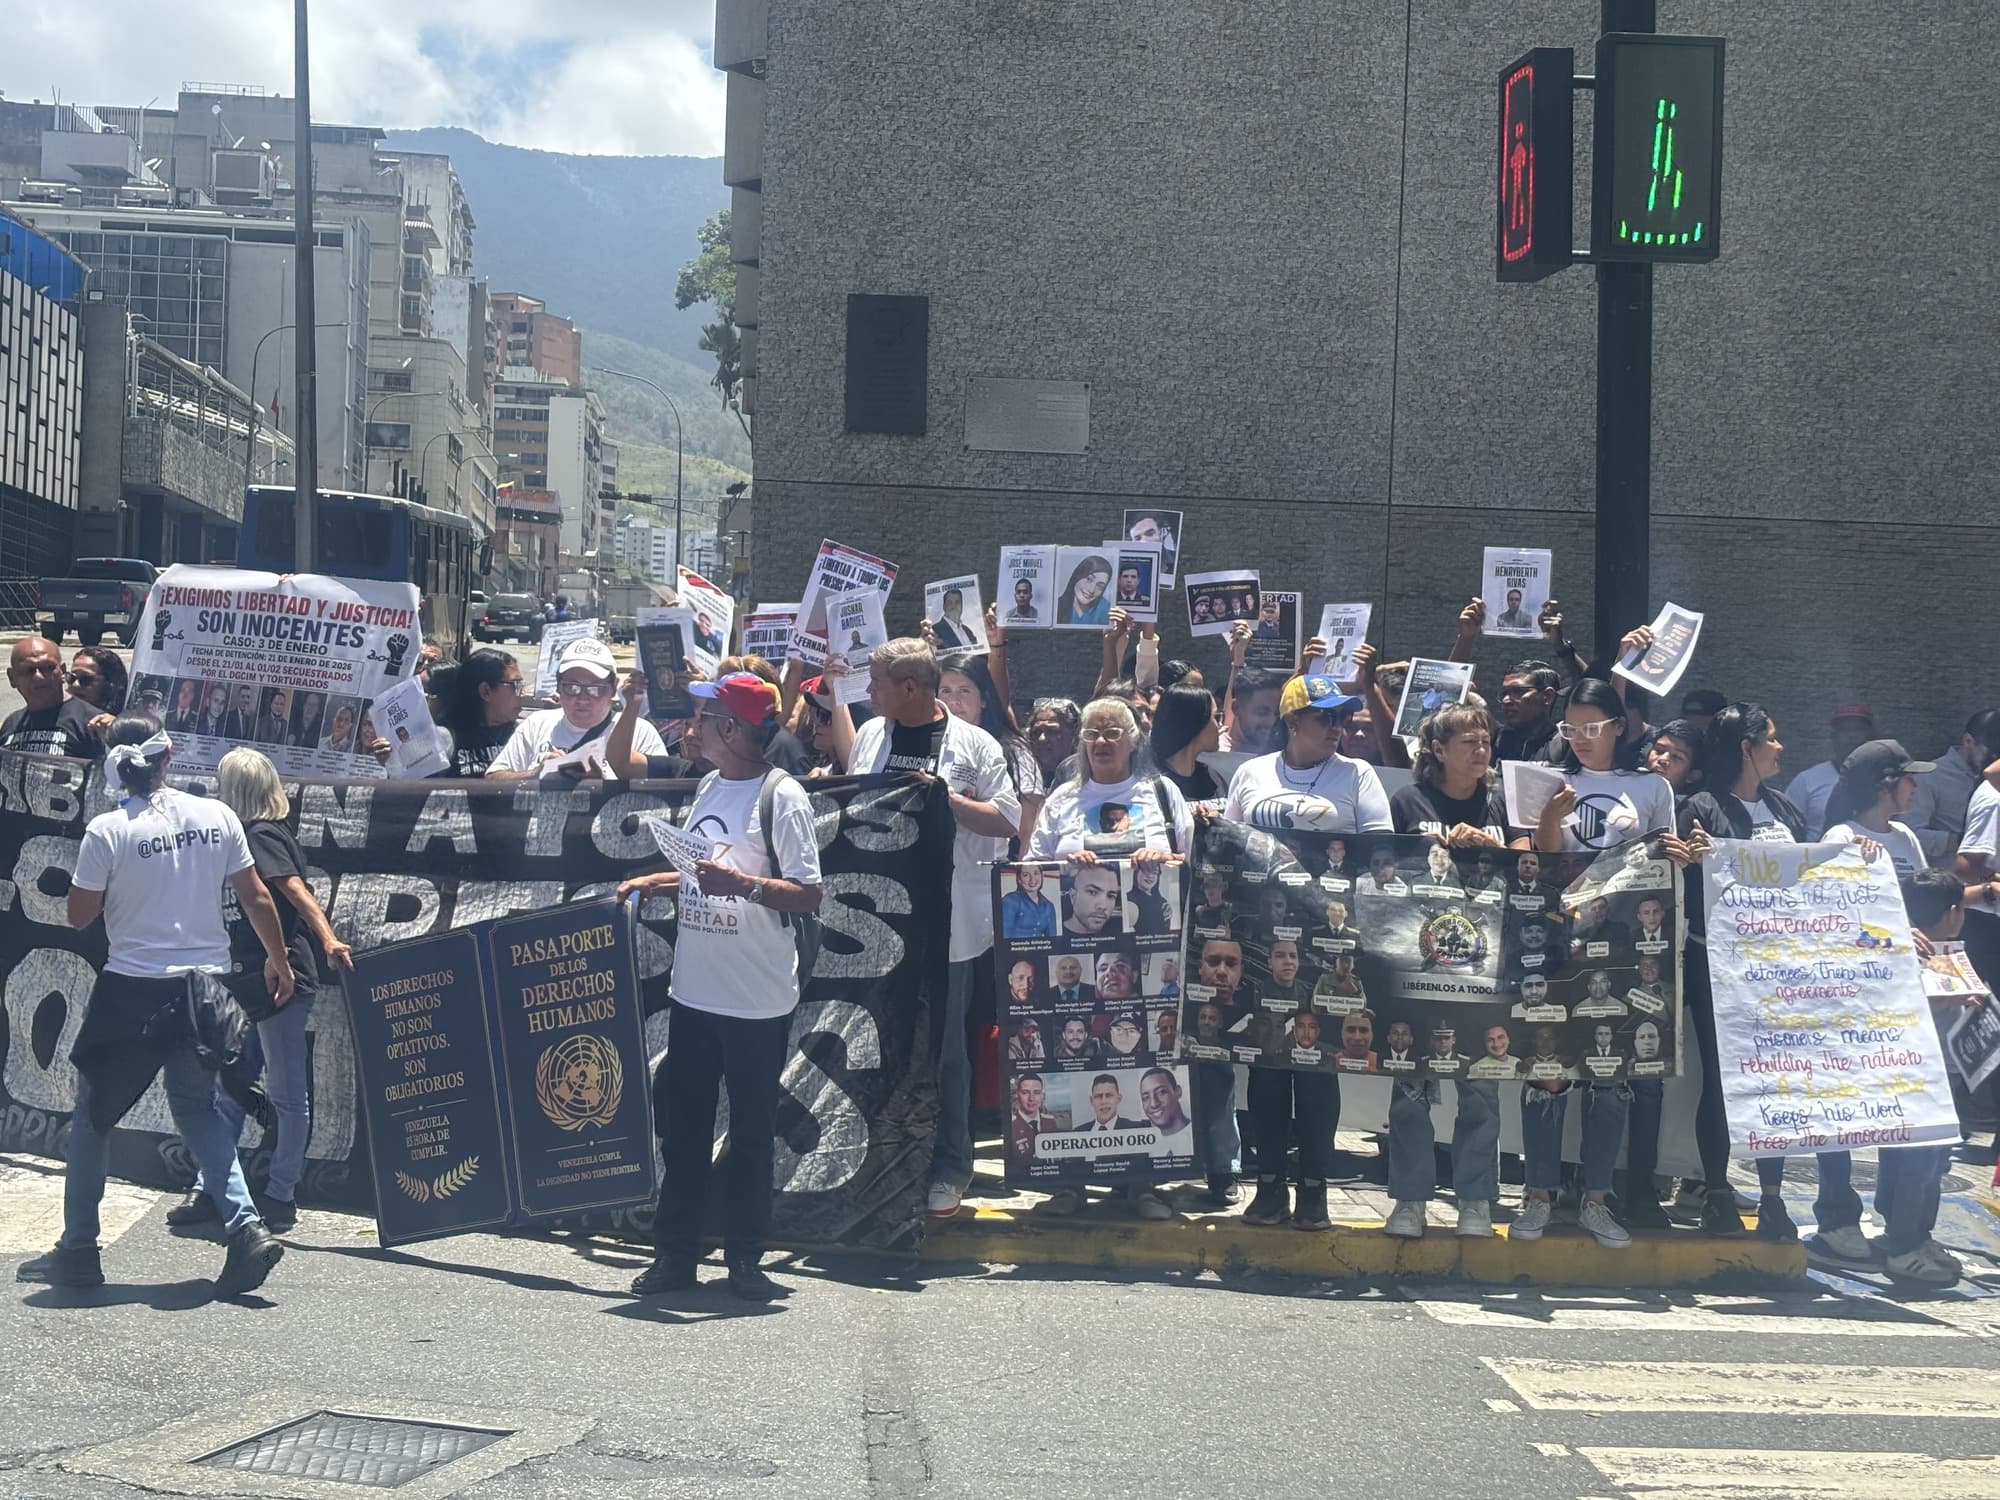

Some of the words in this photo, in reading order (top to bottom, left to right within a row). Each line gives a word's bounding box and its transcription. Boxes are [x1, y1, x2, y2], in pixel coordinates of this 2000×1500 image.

[159, 586, 231, 609] ¡EXIGIMOS
[236, 590, 310, 616] LIBERTAD
[316, 600, 327, 617] Y
[329, 602, 415, 629] JUSTICIA!
[197, 609, 238, 633] SON
[240, 612, 367, 649] INOCENTES
[223, 635, 255, 649] CASO:
[258, 639, 266, 649] 3
[268, 640, 283, 651] DE
[286, 641, 328, 656] ENERO
[800, 636, 827, 653] FERNAN
[191, 647, 214, 657] FECHA
[214, 649, 224, 657] DE
[225, 649, 267, 662] DETENCIÓN:
[267, 653, 276, 662] 21
[276, 654, 287, 662] DE
[289, 655, 317, 667] ENERO
[318, 660, 330, 668] DE
[186, 657, 210, 667] DESDE
[210, 659, 221, 668] EL
[222, 659, 242, 670] 21/01
[243, 662, 254, 671] AL
[256, 662, 281, 674] 01/02
[282, 666, 353, 682] SECUESTRADOS
[201, 668, 218, 678] POR
[219, 669, 228, 678] EL
[229, 671, 256, 681] DGCIM
[259, 673, 265, 682] Y
[266, 674, 329, 690] TORTURADOS
[138, 828, 221, 859] @CLIPPVE
[685, 898, 697, 907] POR
[700, 901, 708, 909] LA
[702, 926, 739, 935] POLÍTICOS
[510, 924, 615, 968] PASAPORTE
[549, 963, 566, 978] DE
[567, 958, 588, 974] LOS
[371, 984, 389, 1003] LOS
[388, 970, 455, 997] DERECHOS
[521, 970, 616, 1009] DERECHOS
[1402, 981, 1456, 993] LIBÉRENLOS
[1466, 986, 1498, 995] TODO
[384, 993, 442, 1020] HUMANOS
[527, 997, 616, 1034] HUMANOS
[392, 1021, 406, 1038] NO
[407, 1015, 433, 1034] SON
[387, 1033, 451, 1061] OPTATIVOS.
[404, 1058, 427, 1077] SON
[385, 1071, 464, 1102] OBLIGATORIOS
[404, 1114, 450, 1133] VENEZUELA
[406, 1134, 415, 1147] ES
[414, 1131, 435, 1145] HORA
[437, 1129, 450, 1142] DE
[1041, 1136, 1124, 1151] OPERACION
[1127, 1133, 1156, 1145] ORO
[411, 1143, 448, 1161] CUMPLIR.
[558, 1156, 597, 1169] VENEZUELA
[536, 1177, 546, 1188] LA
[546, 1173, 580, 1187] DIGNIDAD
[582, 1170, 592, 1181] NO
[592, 1168, 610, 1181] TIENE
